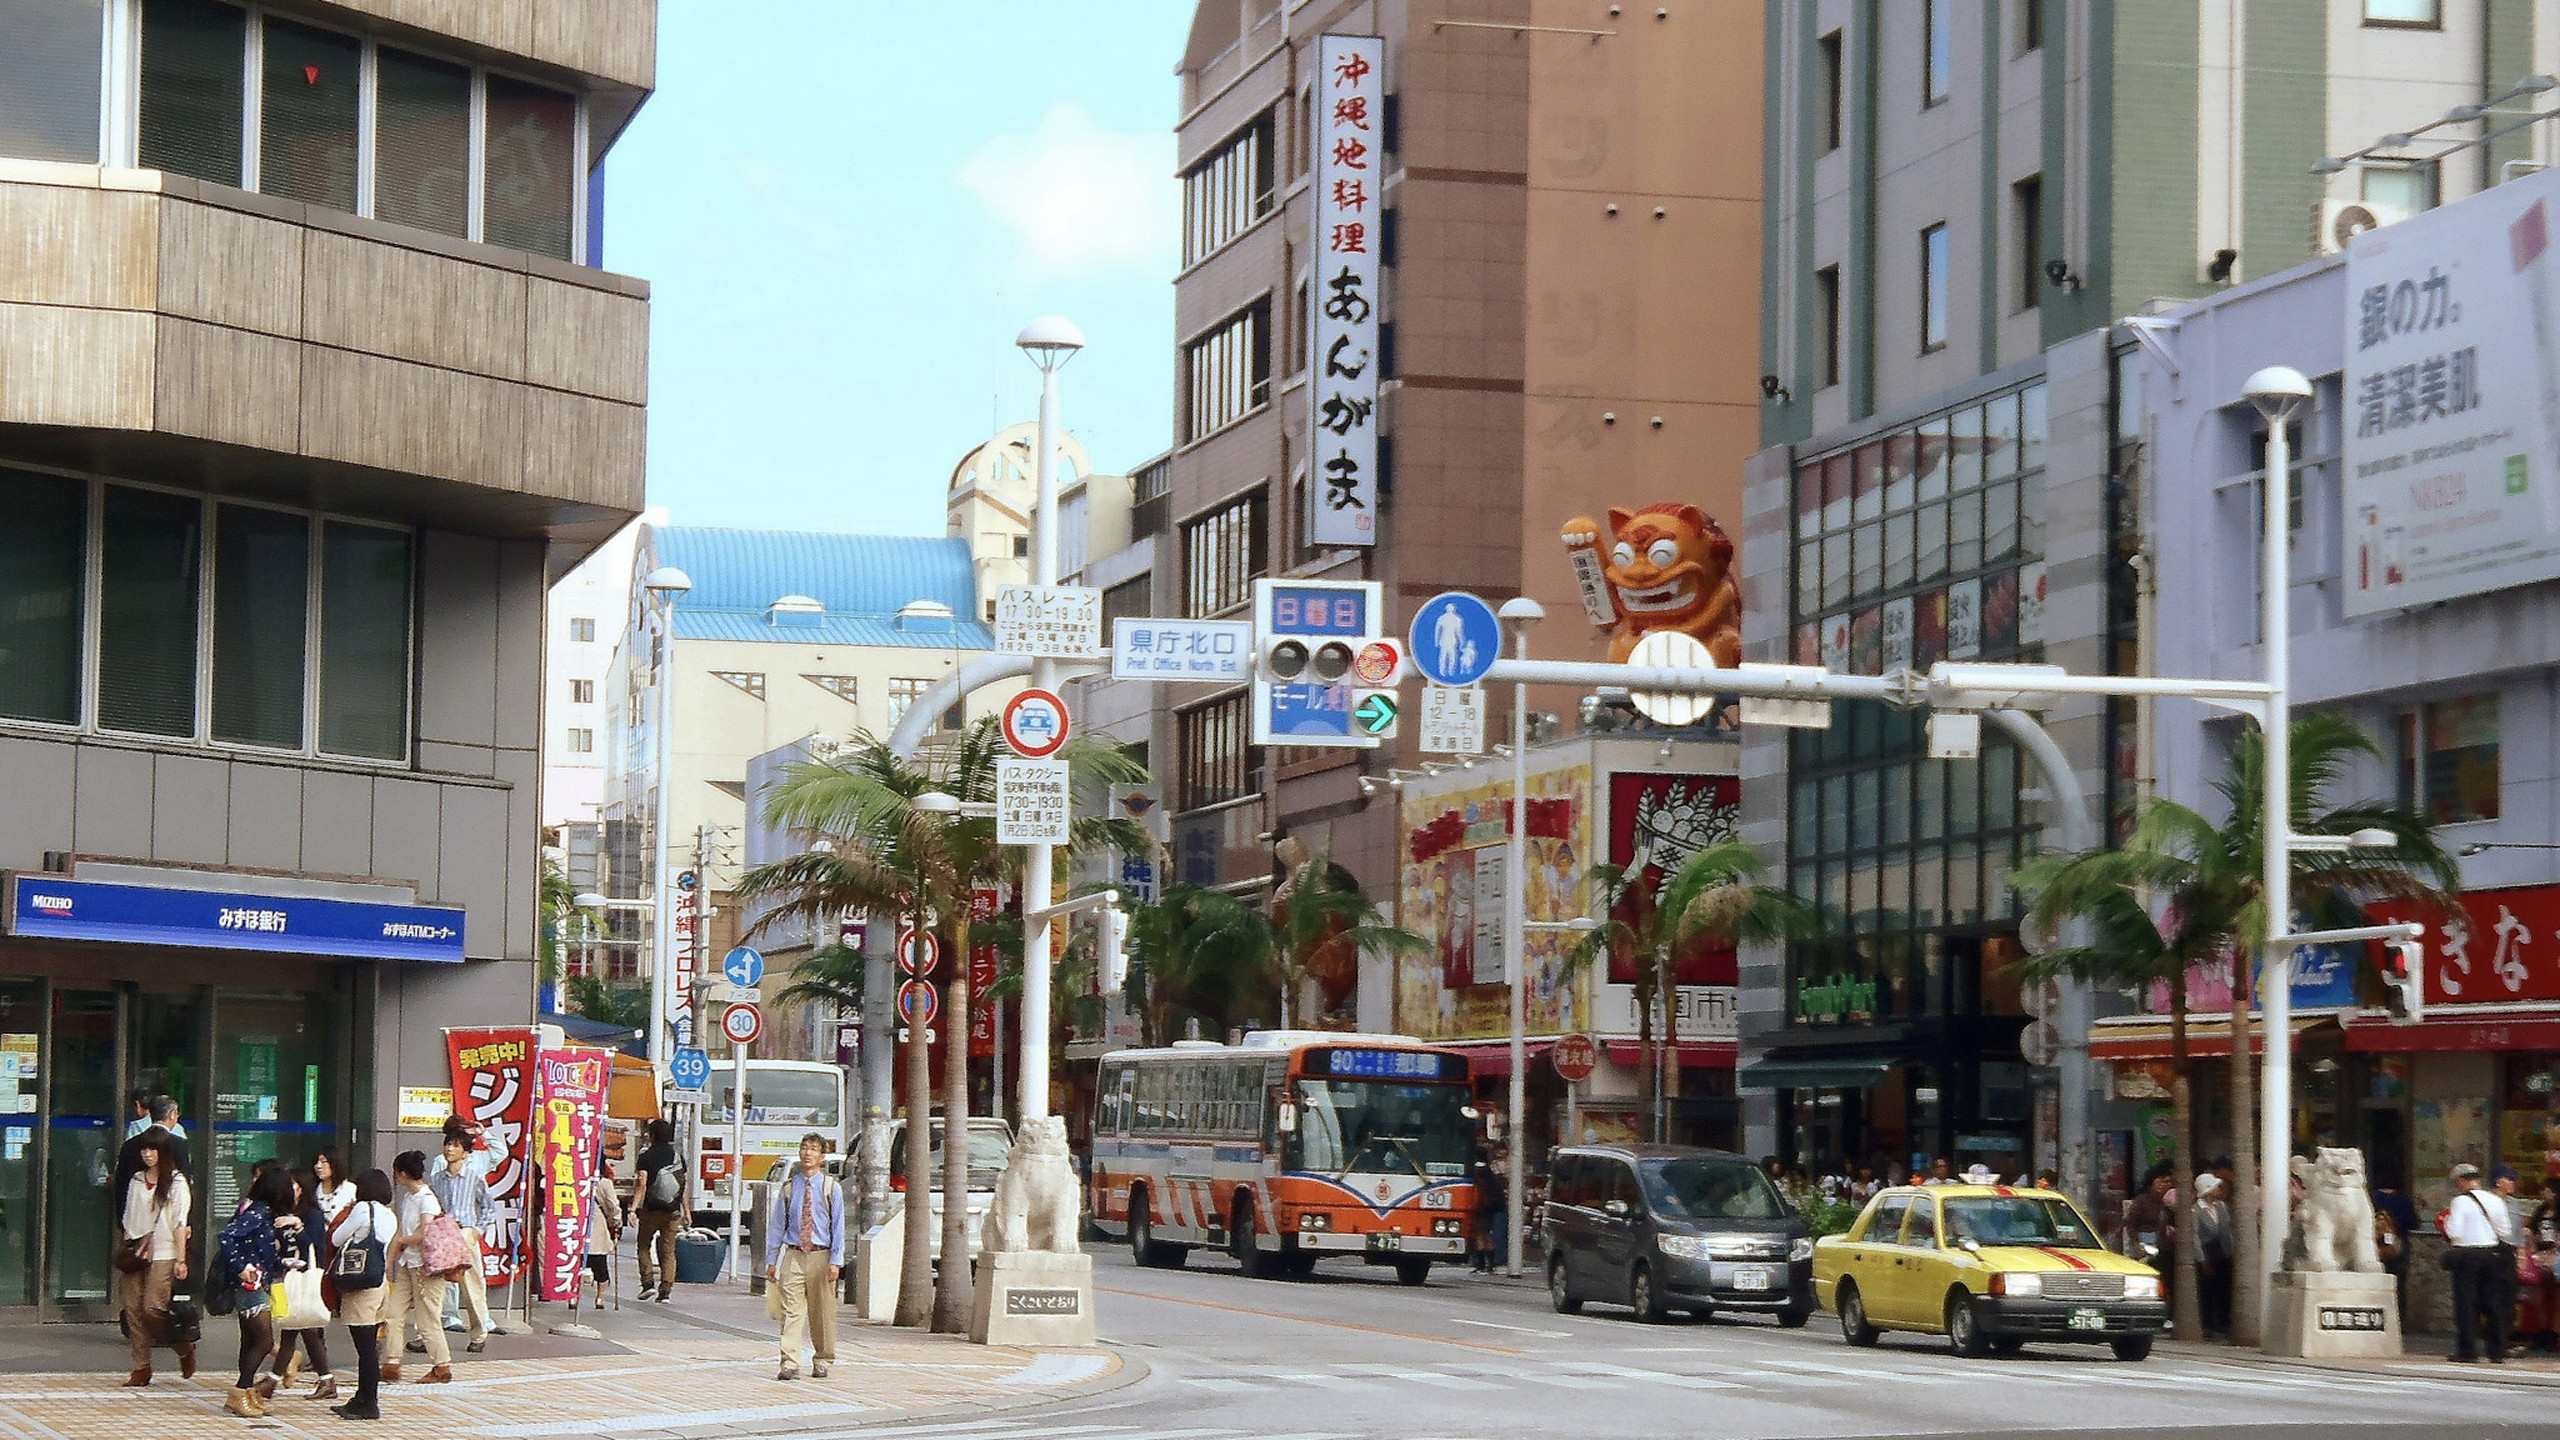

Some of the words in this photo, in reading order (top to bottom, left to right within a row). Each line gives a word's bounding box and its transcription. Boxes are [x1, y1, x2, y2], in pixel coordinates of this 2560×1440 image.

[1329, 52, 1371, 255] 沖縄地料理
[2358, 264, 2463, 352] 銀の力。
[1317, 264, 1373, 511] あんがま
[2356, 345, 2482, 439] 清潔美肌
[1000, 589, 1097, 606] バスレーン
[1277, 596, 1358, 628] 日曜日
[1129, 628, 1236, 655] 県庁北口
[1153, 657, 1181, 671] Office
[1189, 659, 1214, 672] North
[1434, 690, 1471, 706] 日曜
[1428, 706, 1476, 721] 12-18
[32, 894, 74, 910] MIZUHO
[218, 907, 287, 933] みずほ銀行
[382, 922, 457, 940] みずほATMコーナー
[731, 1014, 753, 1032] 30
[459, 1040, 526, 1070] 発売中!
[1331, 1050, 1354, 1071] 90
[677, 1058, 704, 1076] 39
[708, 1159, 723, 1172] 25
[1426, 1193, 1446, 1206] 90
